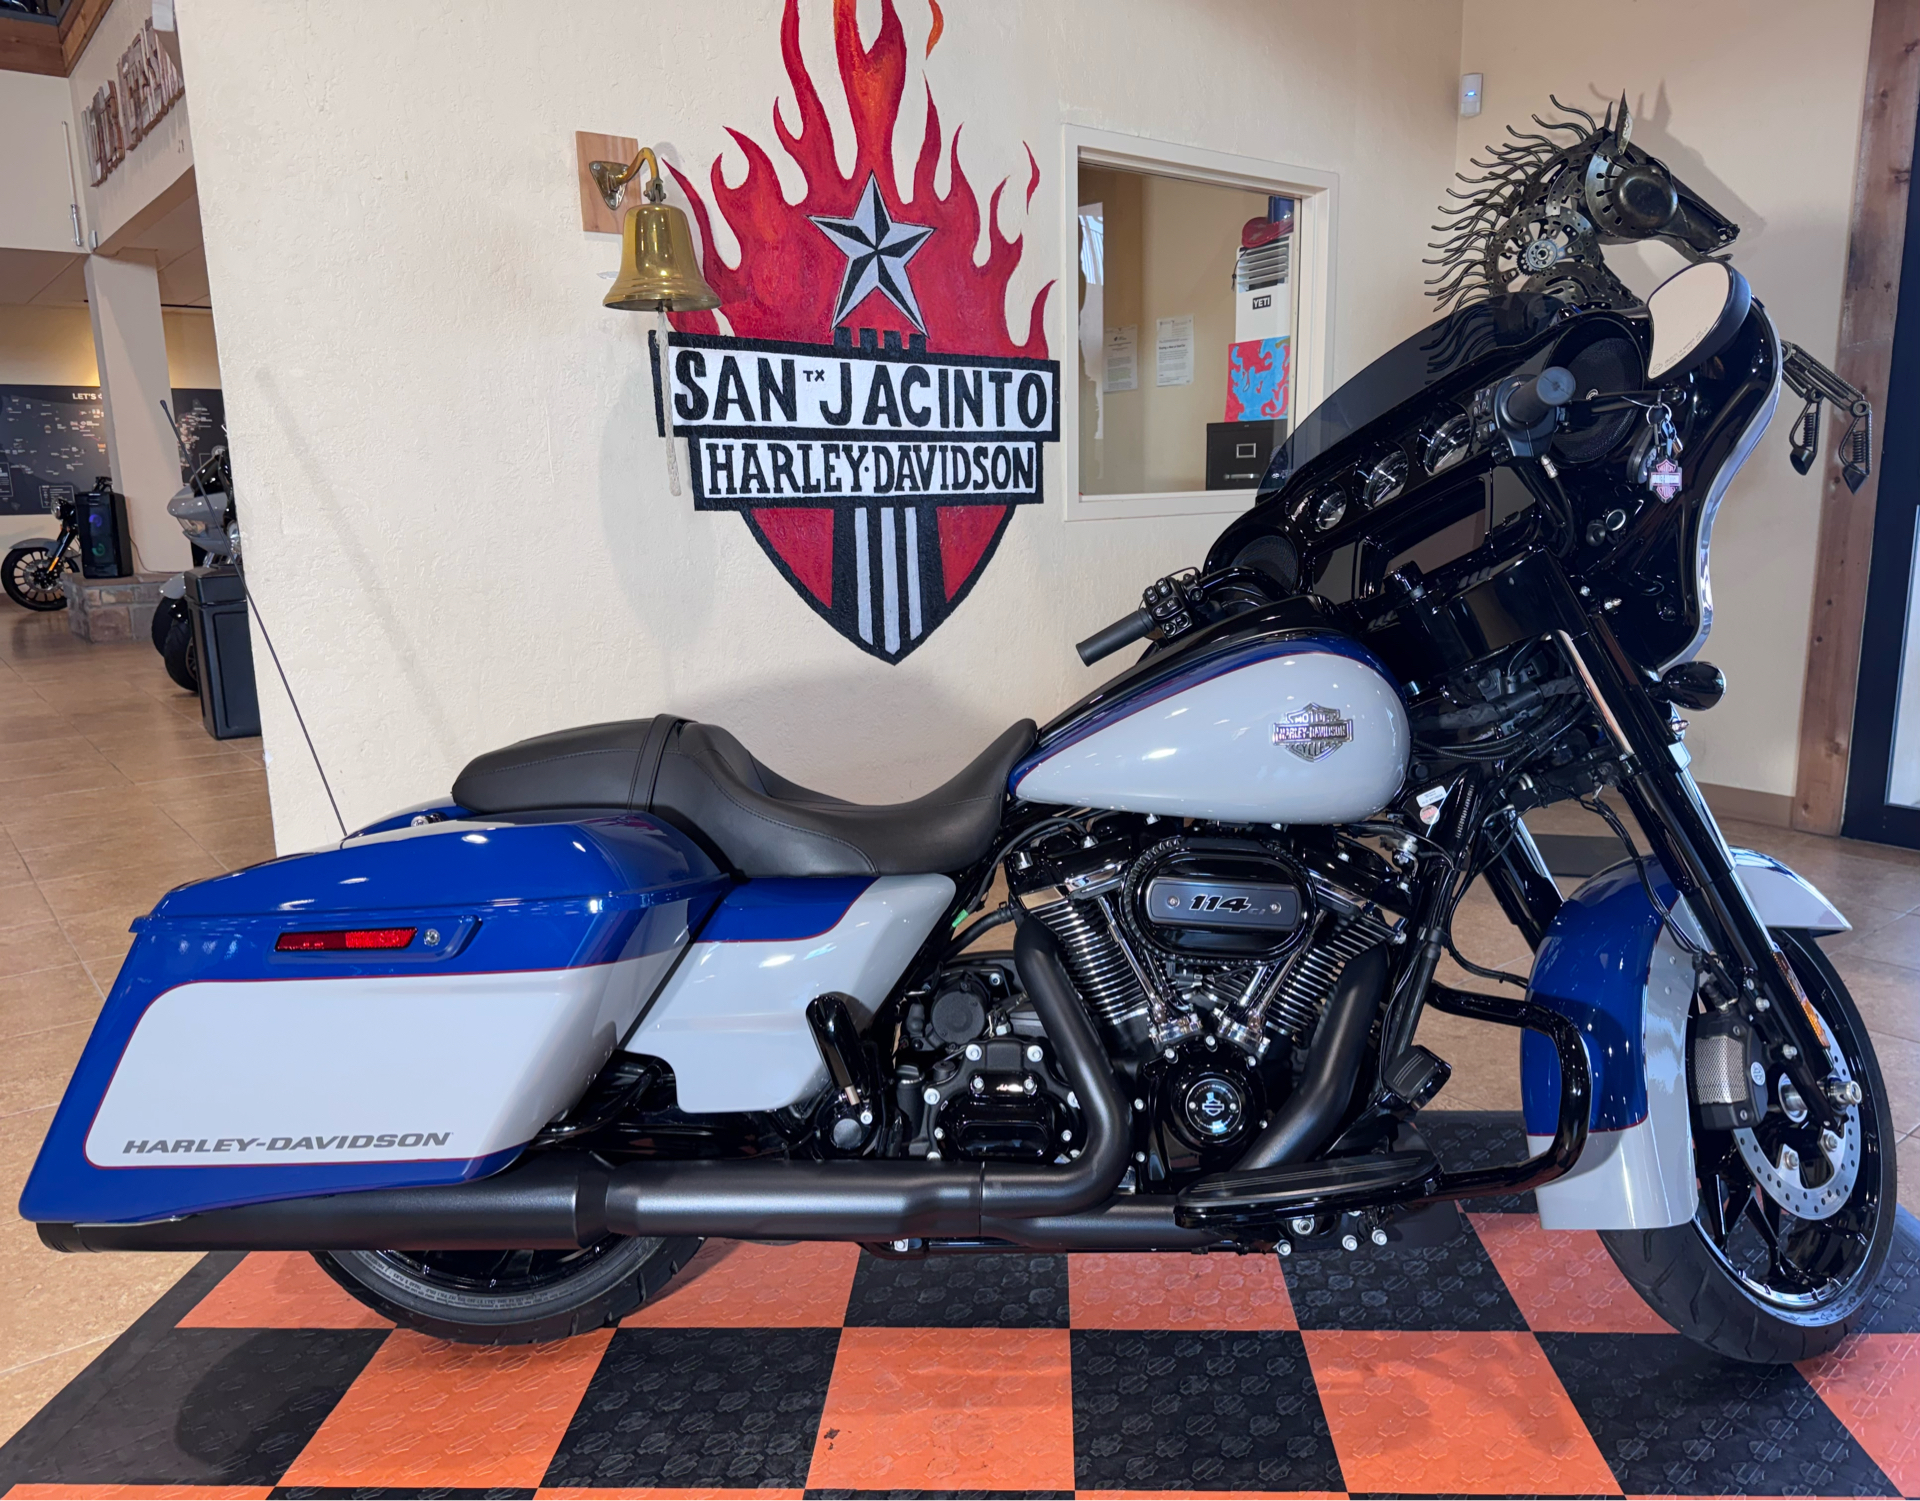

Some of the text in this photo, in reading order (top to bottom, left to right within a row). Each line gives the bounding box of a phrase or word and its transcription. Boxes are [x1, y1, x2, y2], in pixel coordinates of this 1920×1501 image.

[1253, 296, 1271, 308] YETI
[674, 349, 1047, 428] SAN TX JACINTO
[1189, 894, 1251, 913] 114
[122, 1132, 452, 1154] HARLEY-DAVIDSON
